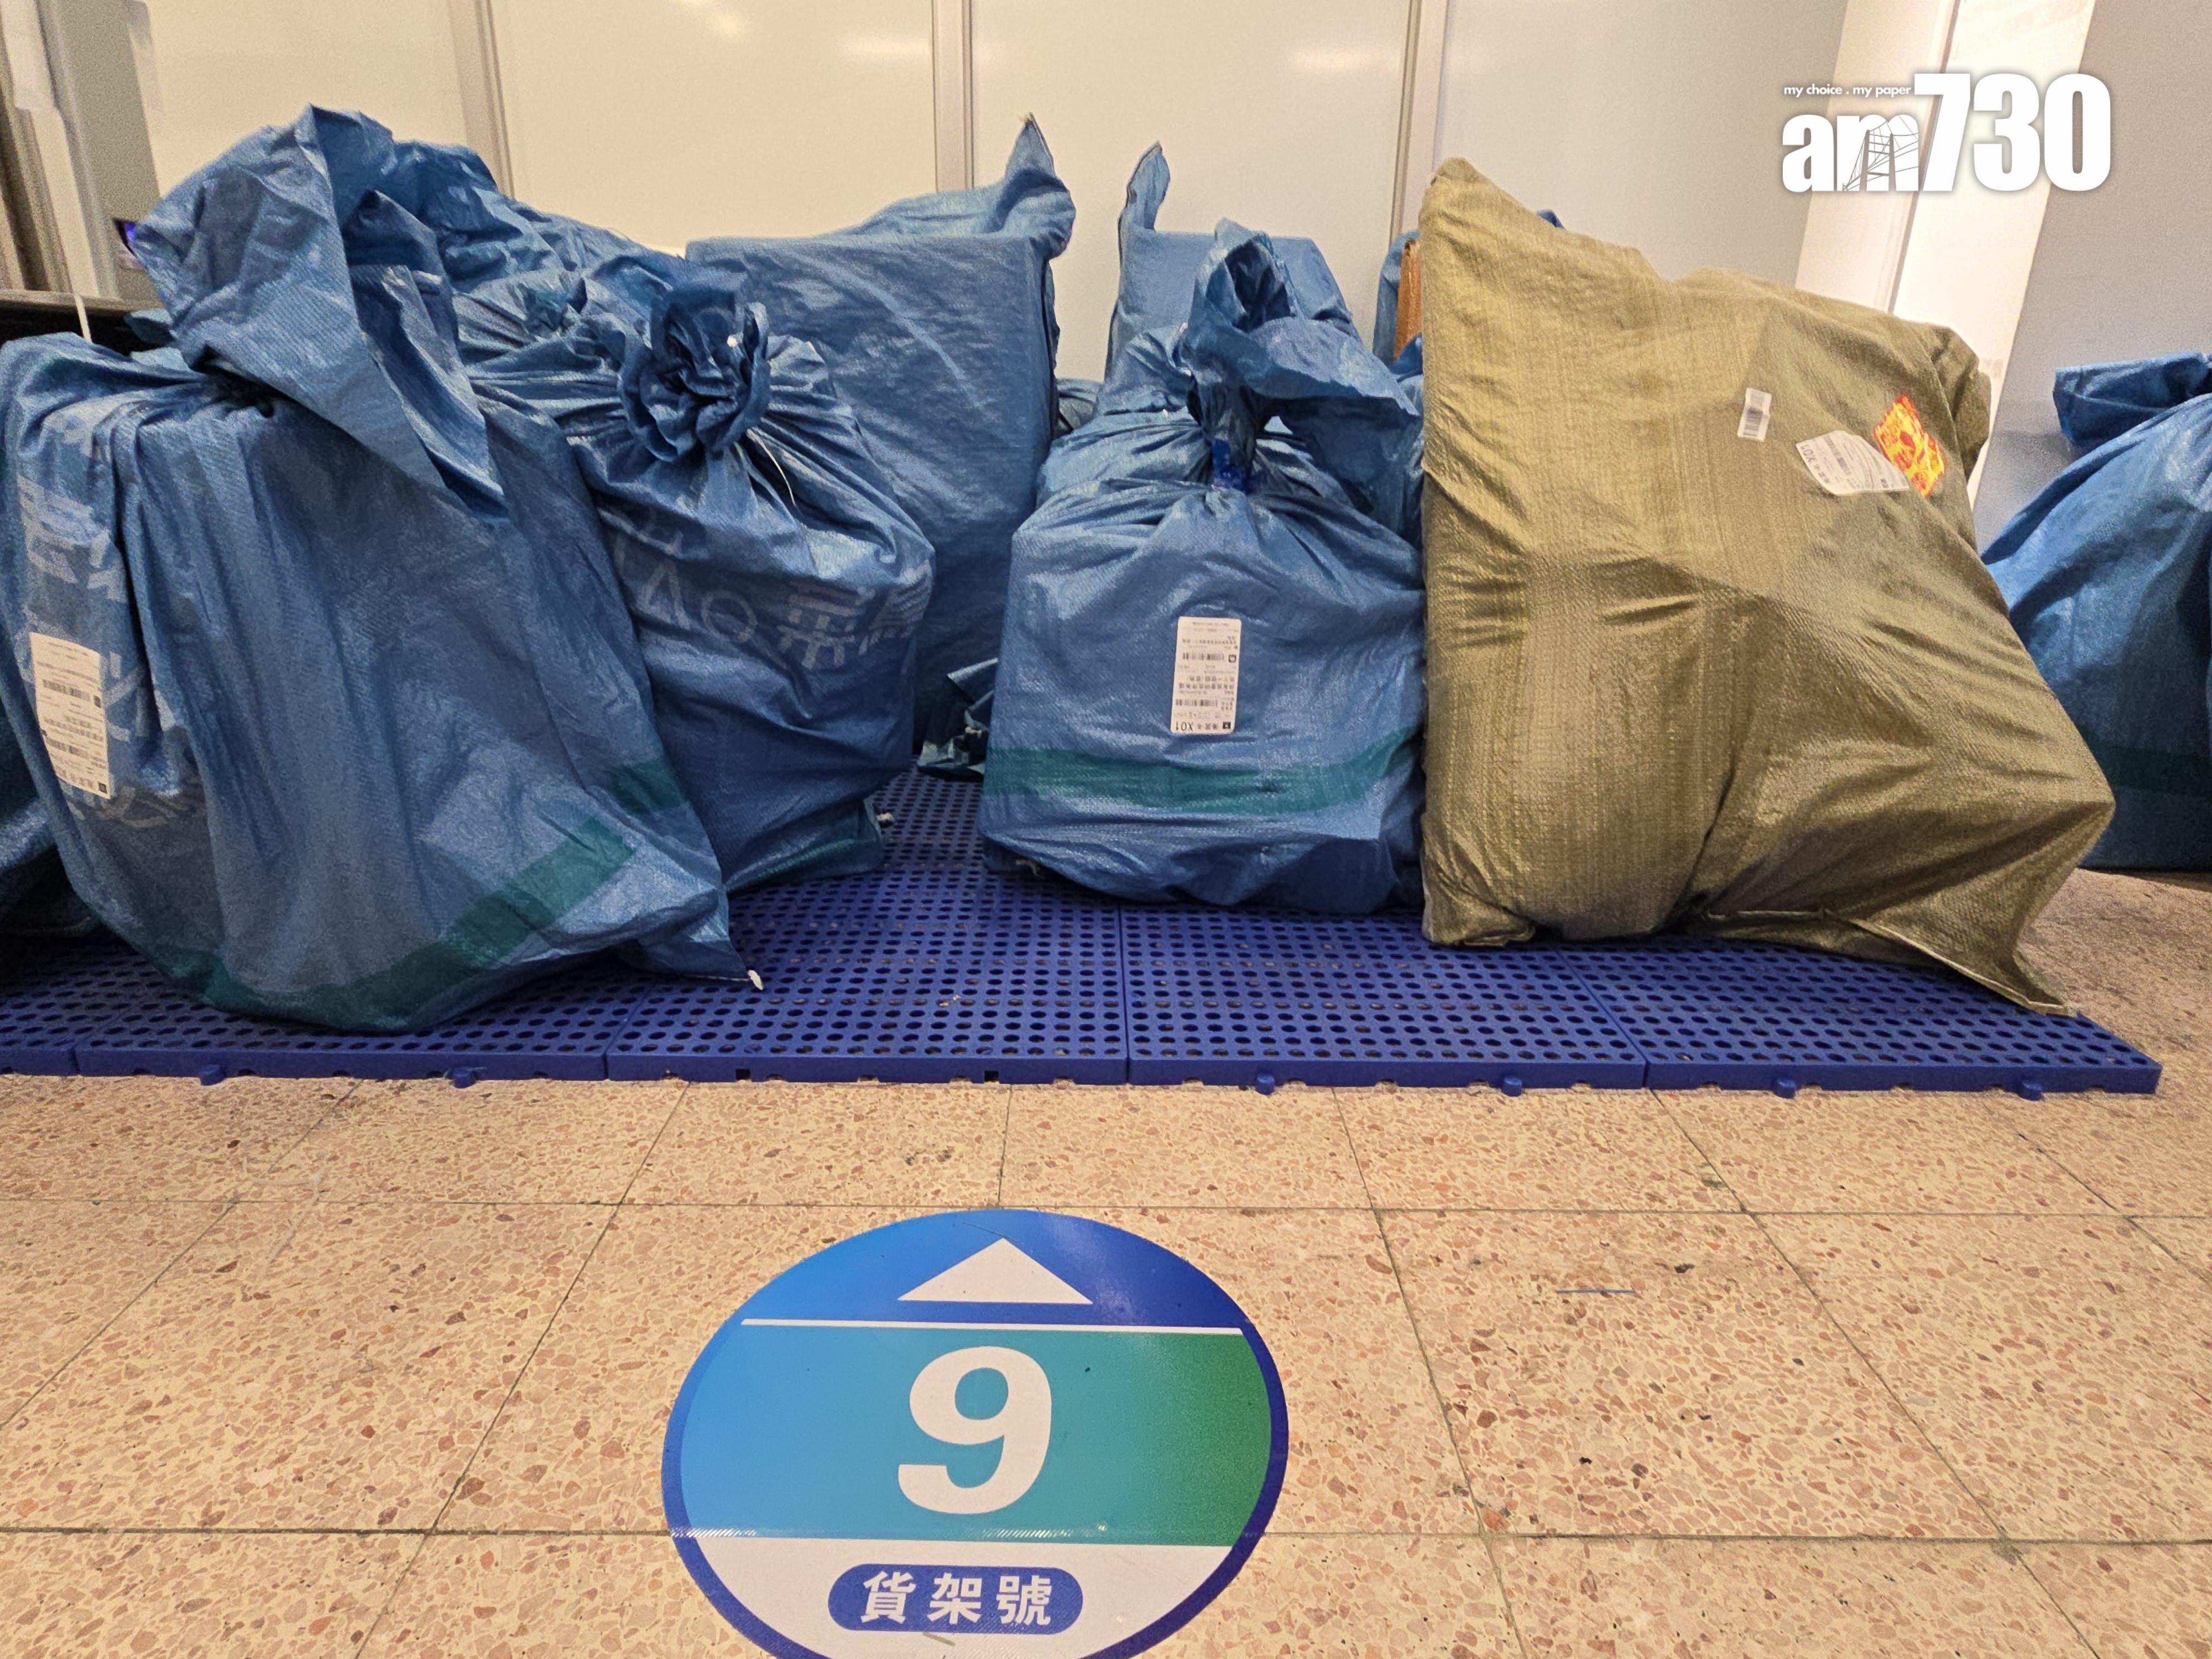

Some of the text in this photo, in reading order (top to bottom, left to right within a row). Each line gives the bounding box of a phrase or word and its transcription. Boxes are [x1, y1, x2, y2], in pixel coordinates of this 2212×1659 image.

[898, 1346, 1052, 1515] 9
[860, 1571, 1052, 1625] 貨架號
